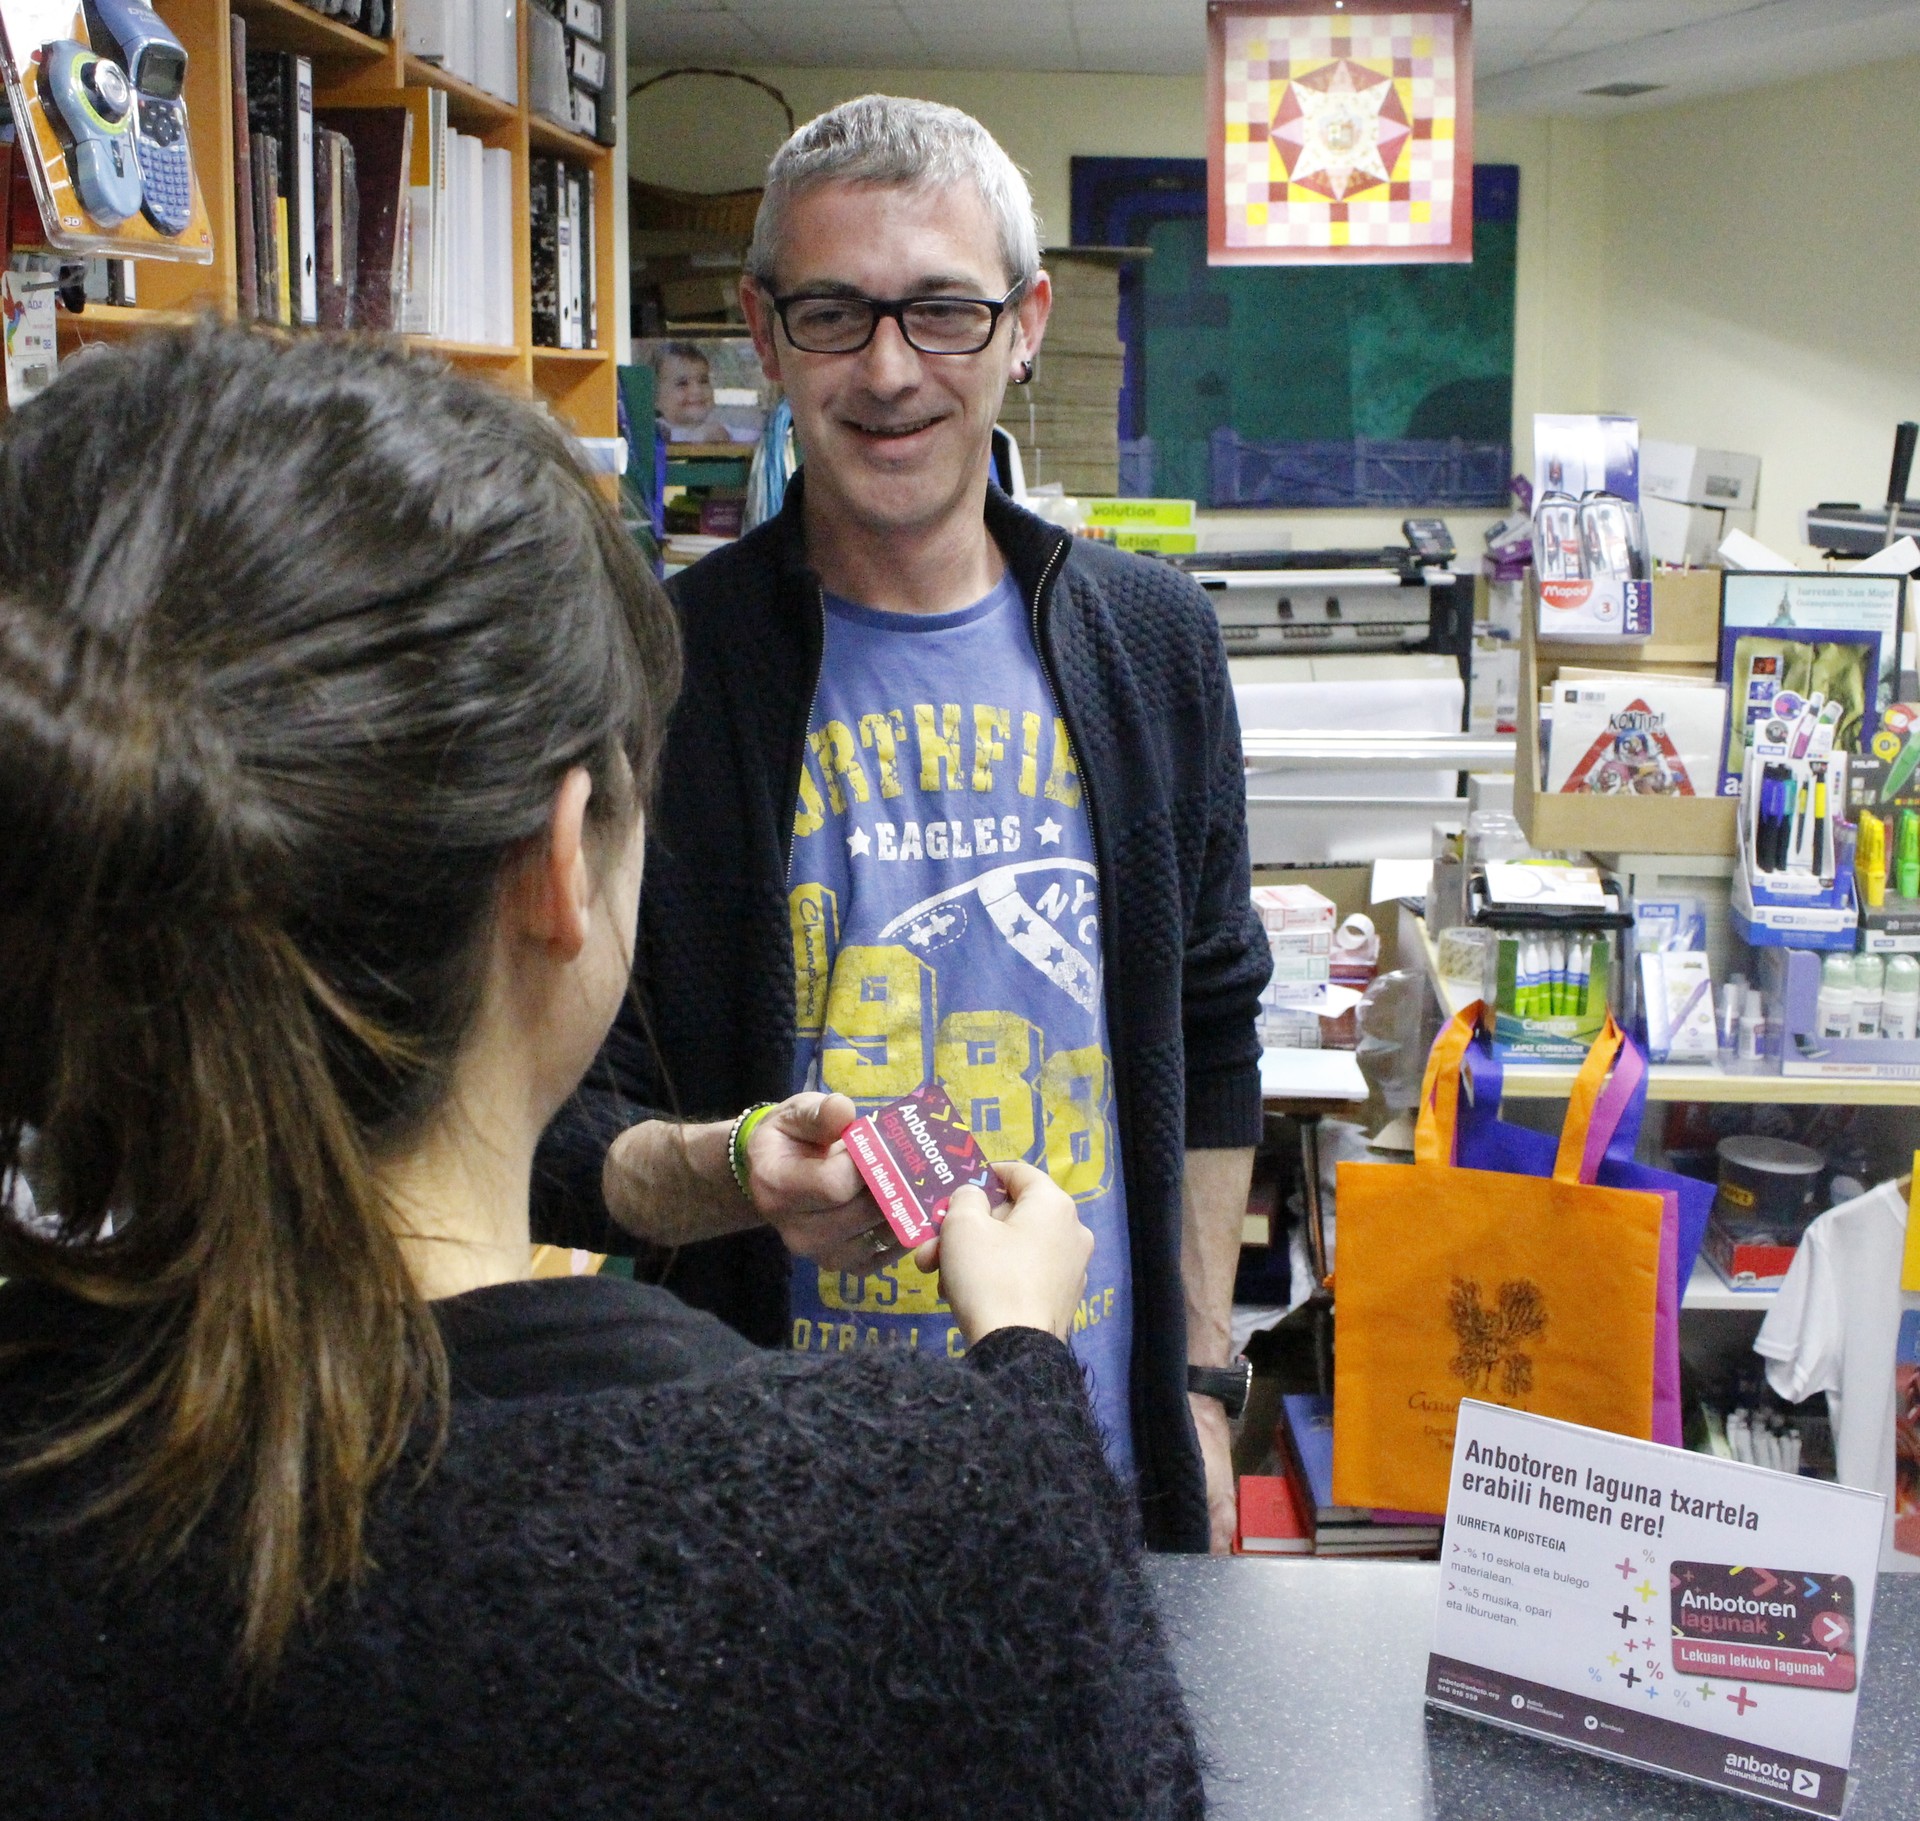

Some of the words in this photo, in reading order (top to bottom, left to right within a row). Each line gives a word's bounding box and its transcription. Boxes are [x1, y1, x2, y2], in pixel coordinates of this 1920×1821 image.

[1626, 582, 1639, 632] STOP
[875, 815, 1021, 861] EAGLES
[882, 1111, 928, 1176] lagunak
[898, 1104, 955, 1185] Anbotoren
[850, 1127, 878, 1166] Lekuan
[871, 1163, 897, 1200] lekuko
[890, 1197, 922, 1240] lagunak
[1464, 1439, 1577, 1487] Anbotoren
[1586, 1468, 1662, 1507] laguna
[1670, 1489, 1759, 1531] txartela
[1462, 1472, 1532, 1505] erabili
[1539, 1486, 1612, 1526] hemen
[1620, 1510, 1665, 1538] ere!
[1456, 1514, 1501, 1535] IURRETA
[1504, 1526, 1566, 1552] KOPISTEGIA
[1451, 1561, 1515, 1586] materialean.
[1481, 1551, 1494, 1563] 10
[1496, 1557, 1531, 1574] eskola
[1533, 1566, 1550, 1578] eta
[1553, 1569, 1590, 1589] bulego
[1446, 1599, 1463, 1611] eta
[1465, 1603, 1519, 1627] liburuetan.
[1481, 1592, 1522, 1612] musika,
[1525, 1604, 1552, 1619] opari
[1681, 1590, 1797, 1618] Anbotoren
[1681, 1607, 1769, 1636] lagunak
[1681, 1648, 1726, 1666] Lekuan
[1729, 1655, 1772, 1671] lekuko
[1775, 1657, 1826, 1677] lagunak
[1724, 1765, 1789, 1792] komunikabideak
[1725, 1752, 1790, 1781] anboto
